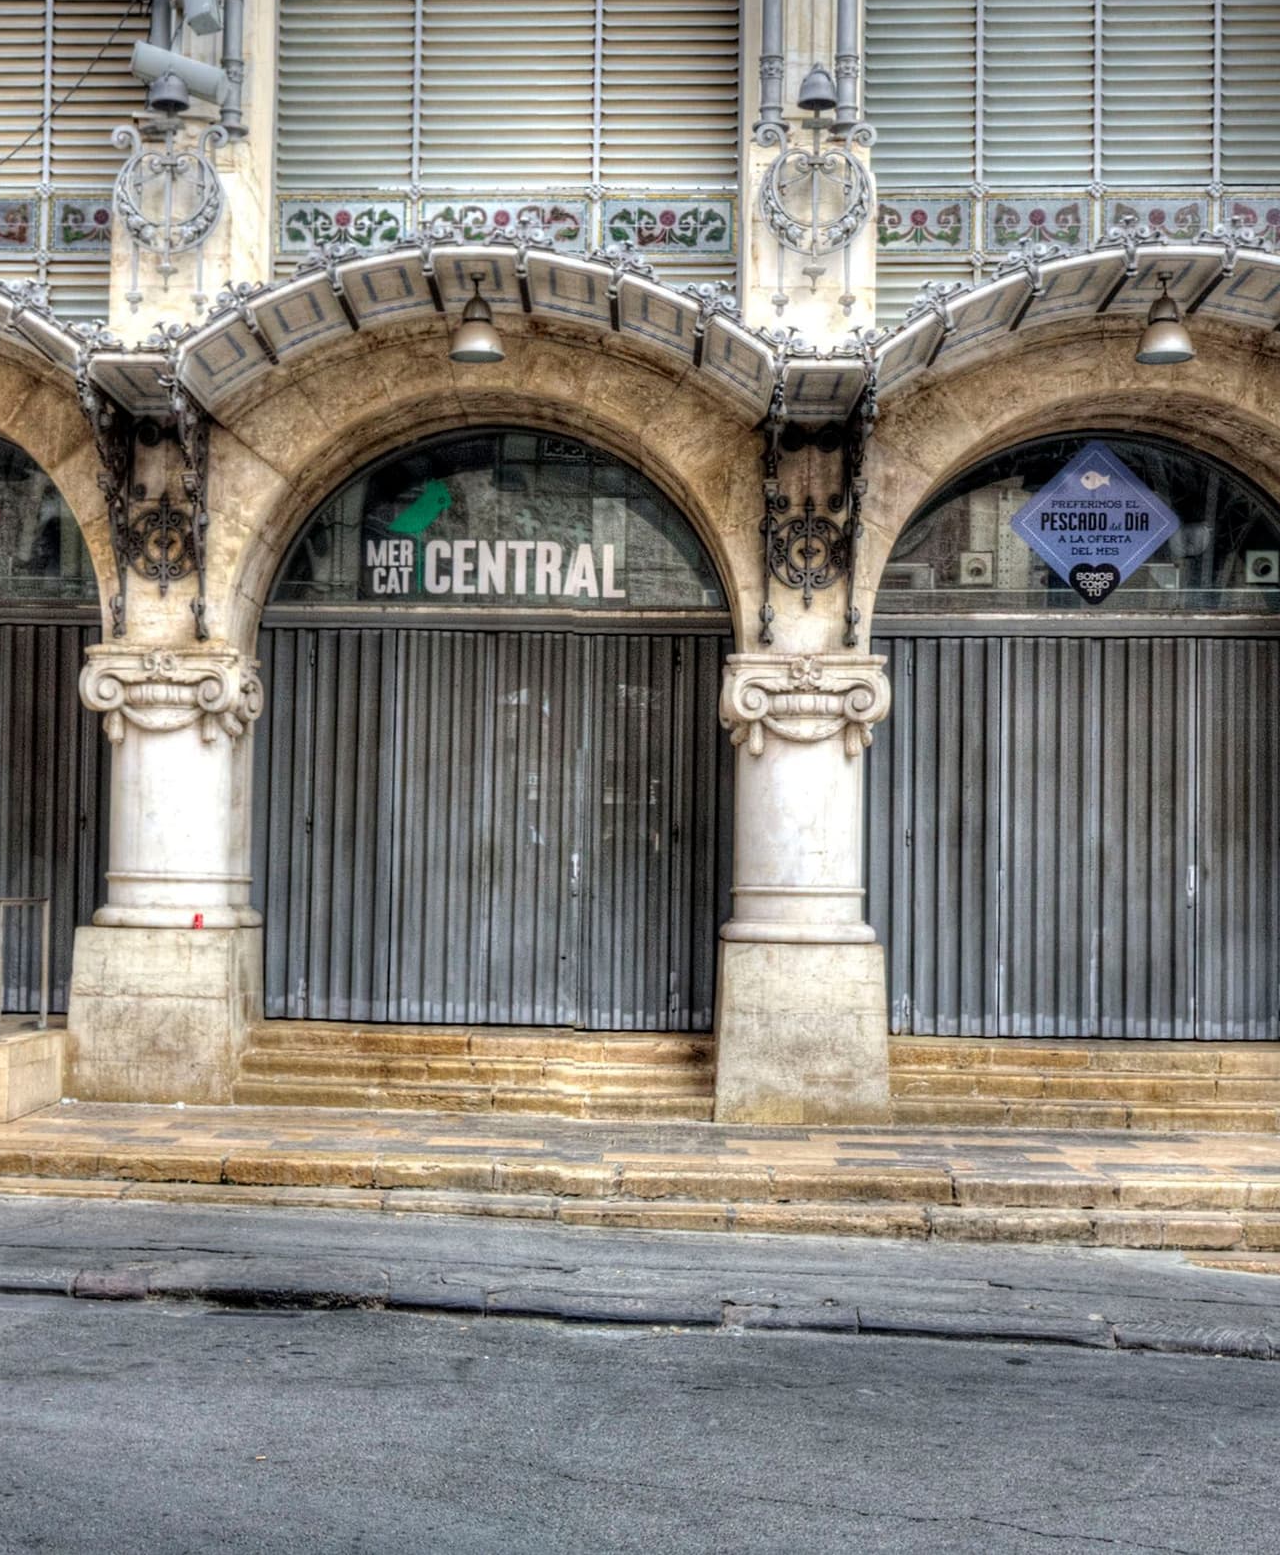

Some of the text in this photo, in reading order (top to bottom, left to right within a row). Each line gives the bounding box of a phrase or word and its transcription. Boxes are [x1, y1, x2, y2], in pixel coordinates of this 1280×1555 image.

[1051, 500, 1139, 509] PREFERIMOS EL
[1041, 512, 1107, 531] PESCADO
[1058, 535, 1132, 543] A LA OFERTA
[366, 540, 413, 567] MER
[1071, 547, 1119, 556] DEL MES
[424, 539, 626, 599] CENTRAL
[373, 567, 413, 594] CAT
[1076, 572, 1114, 581] SOMOS
[1080, 580, 1110, 589] COMO
